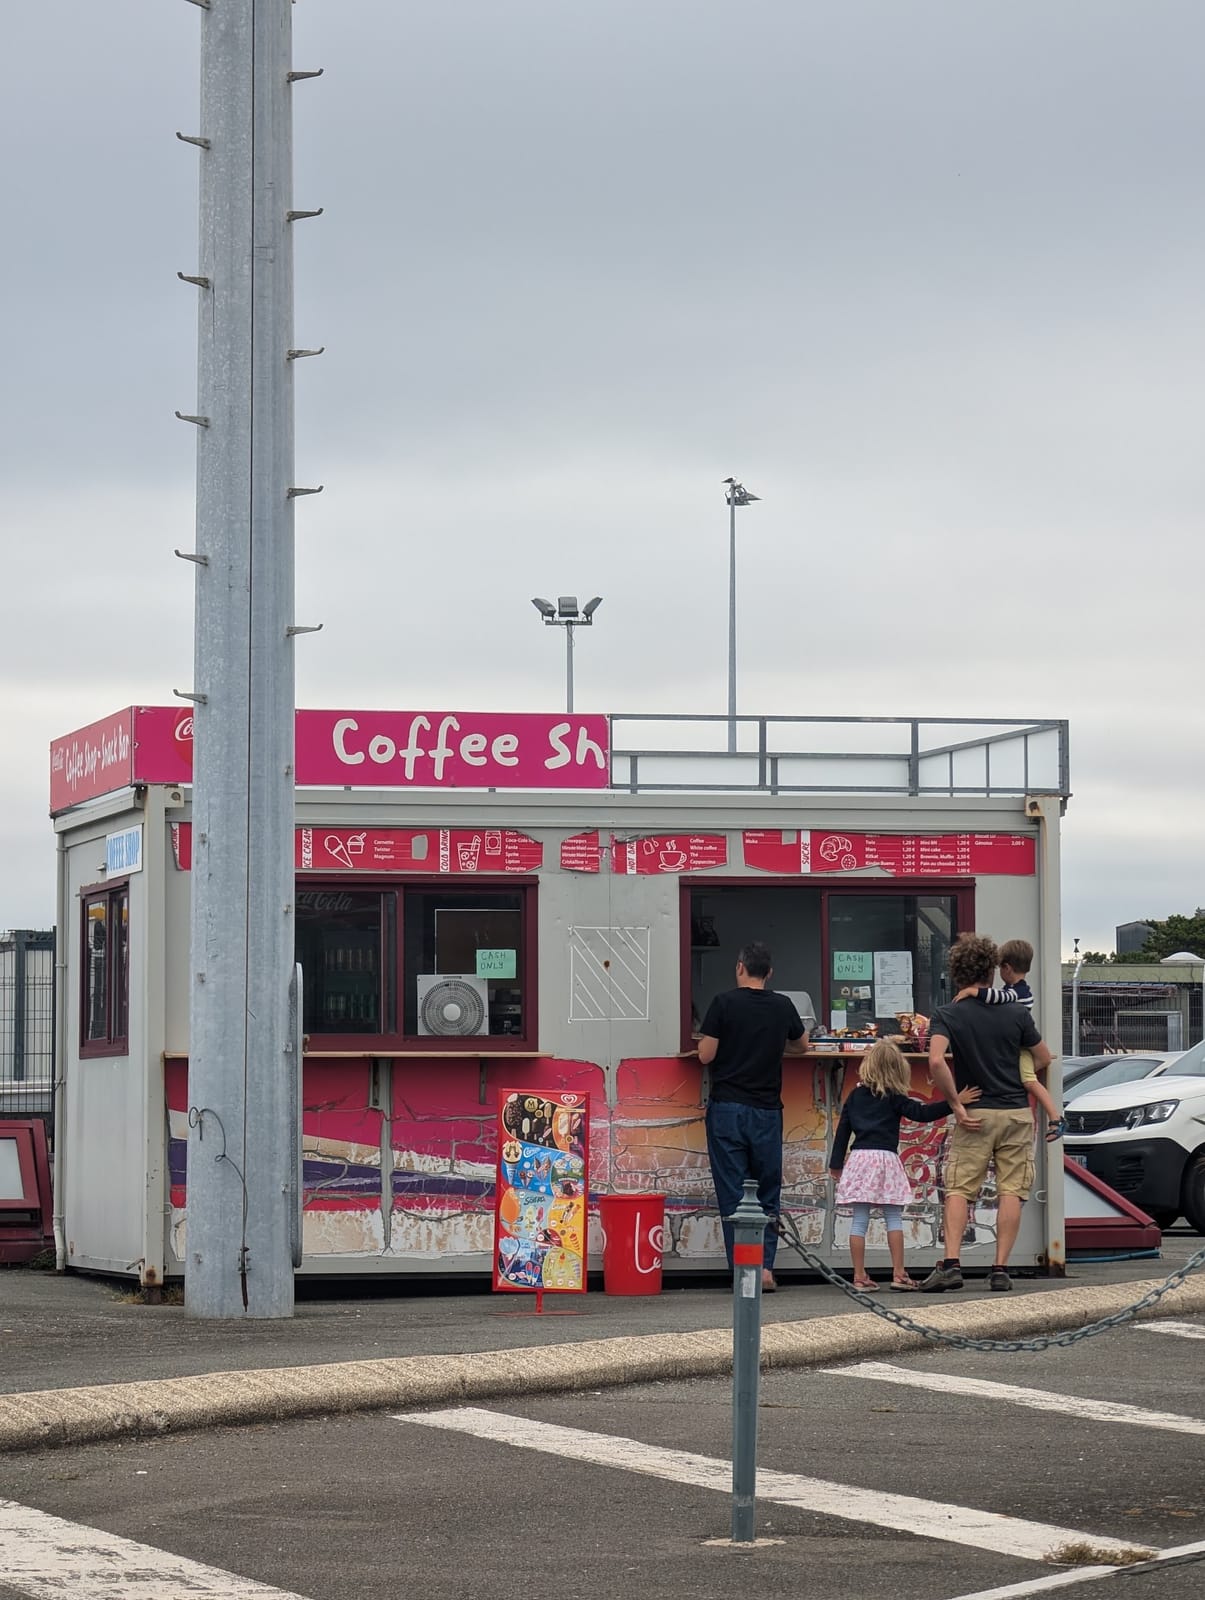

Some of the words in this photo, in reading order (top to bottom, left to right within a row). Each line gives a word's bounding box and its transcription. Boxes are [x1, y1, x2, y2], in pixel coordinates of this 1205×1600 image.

[332, 715, 520, 781] Coffee
[543, 722, 606, 770] Sh
[66, 740, 83, 792] Coffee
[84, 740, 97, 784] Shop
[101, 727, 118, 770] Snack
[118, 724, 130, 761] Bar
[106, 835, 124, 872] COFFEE
[125, 831, 140, 867] SHOP
[801, 841, 810, 865] SUCRE
[302, 857, 311, 868] ICE
[440, 854, 449, 871] COLD
[480, 951, 506, 961] CASH
[838, 953, 864, 963] CASH
[480, 961, 504, 970] ONLY
[837, 964, 864, 973] ONLY
